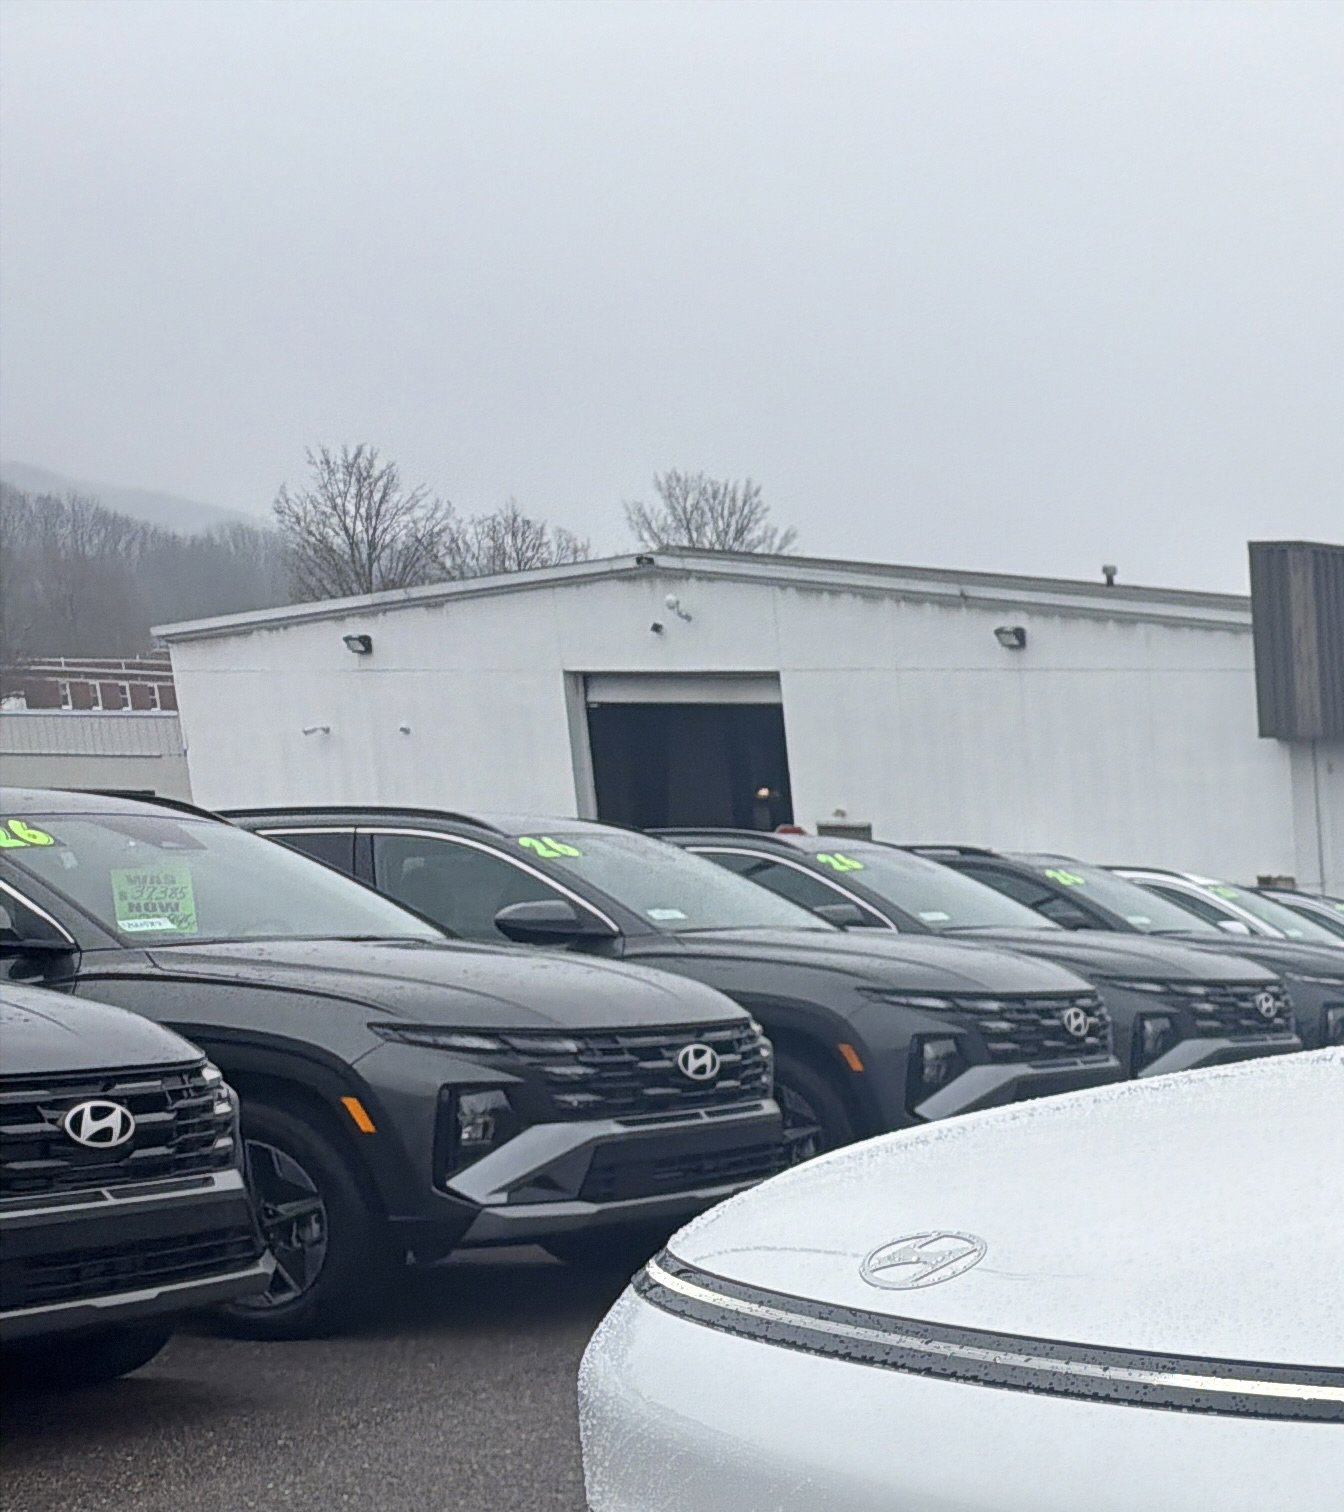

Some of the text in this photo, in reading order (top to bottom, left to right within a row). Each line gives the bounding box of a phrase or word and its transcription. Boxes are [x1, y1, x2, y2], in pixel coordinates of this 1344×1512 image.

[518, 836, 581, 858] 26
[816, 852, 864, 871] 26
[126, 874, 177, 885] WAS
[127, 902, 181, 913] NOW
